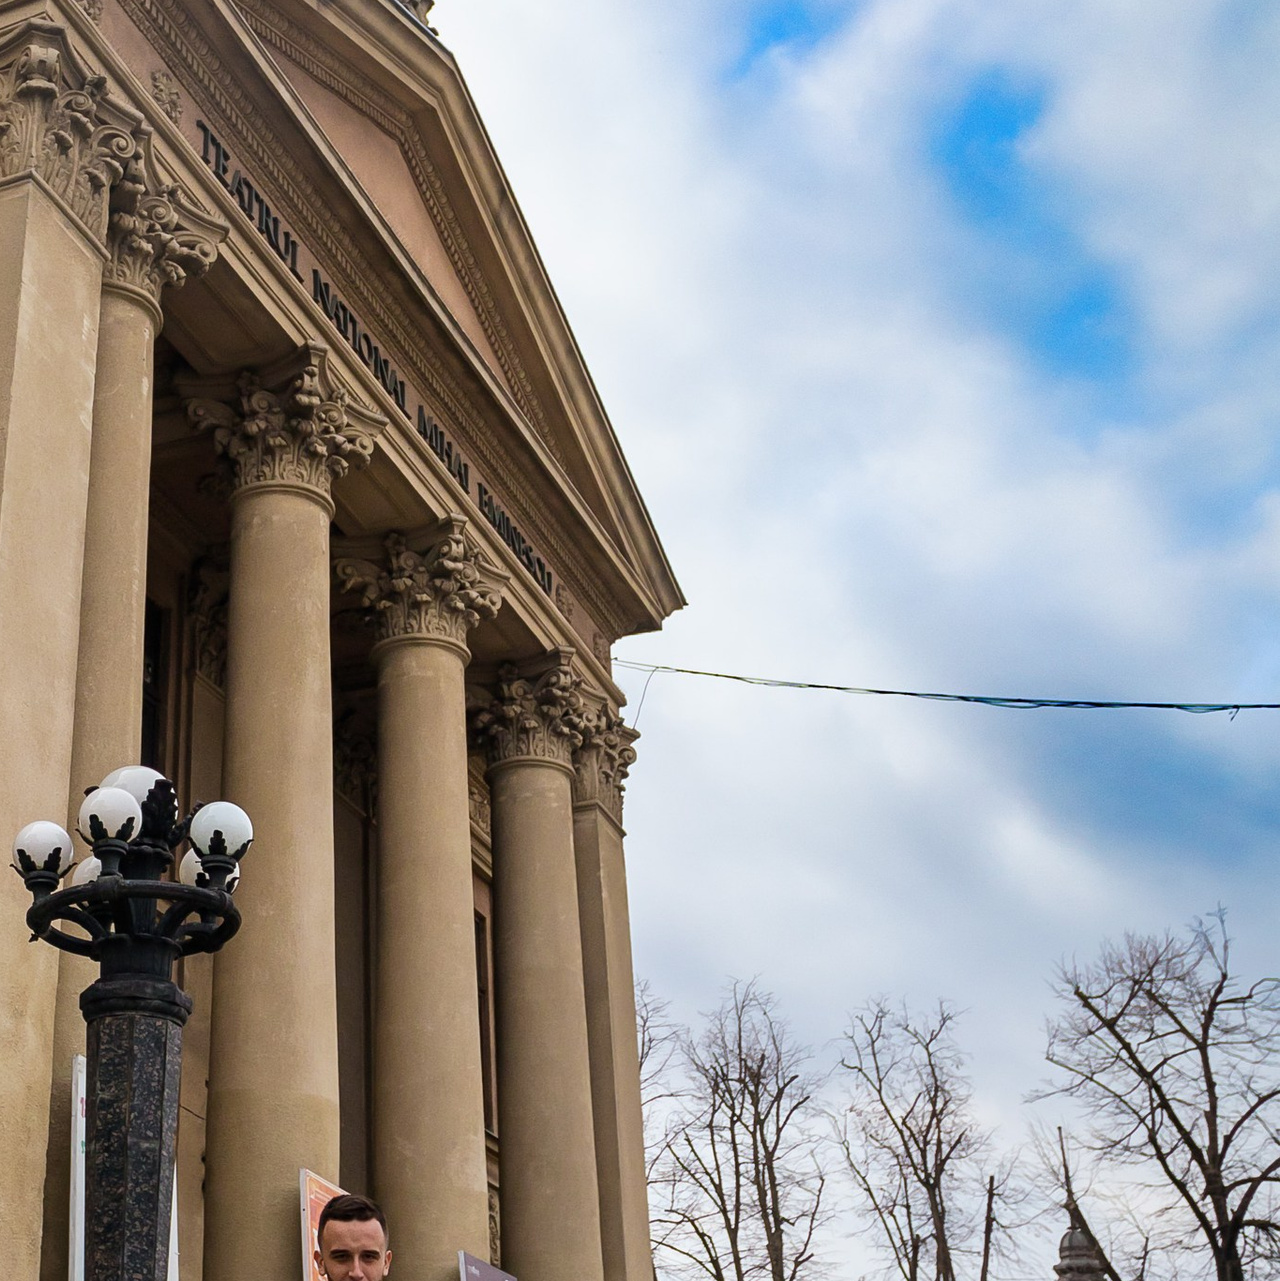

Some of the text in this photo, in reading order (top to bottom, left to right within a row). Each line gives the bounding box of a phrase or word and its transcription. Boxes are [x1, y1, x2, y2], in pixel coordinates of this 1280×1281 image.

[196, 120, 305, 283] TEATRUL
[418, 405, 470, 494] MIHAI
[477, 482, 553, 597] EMINESCU
